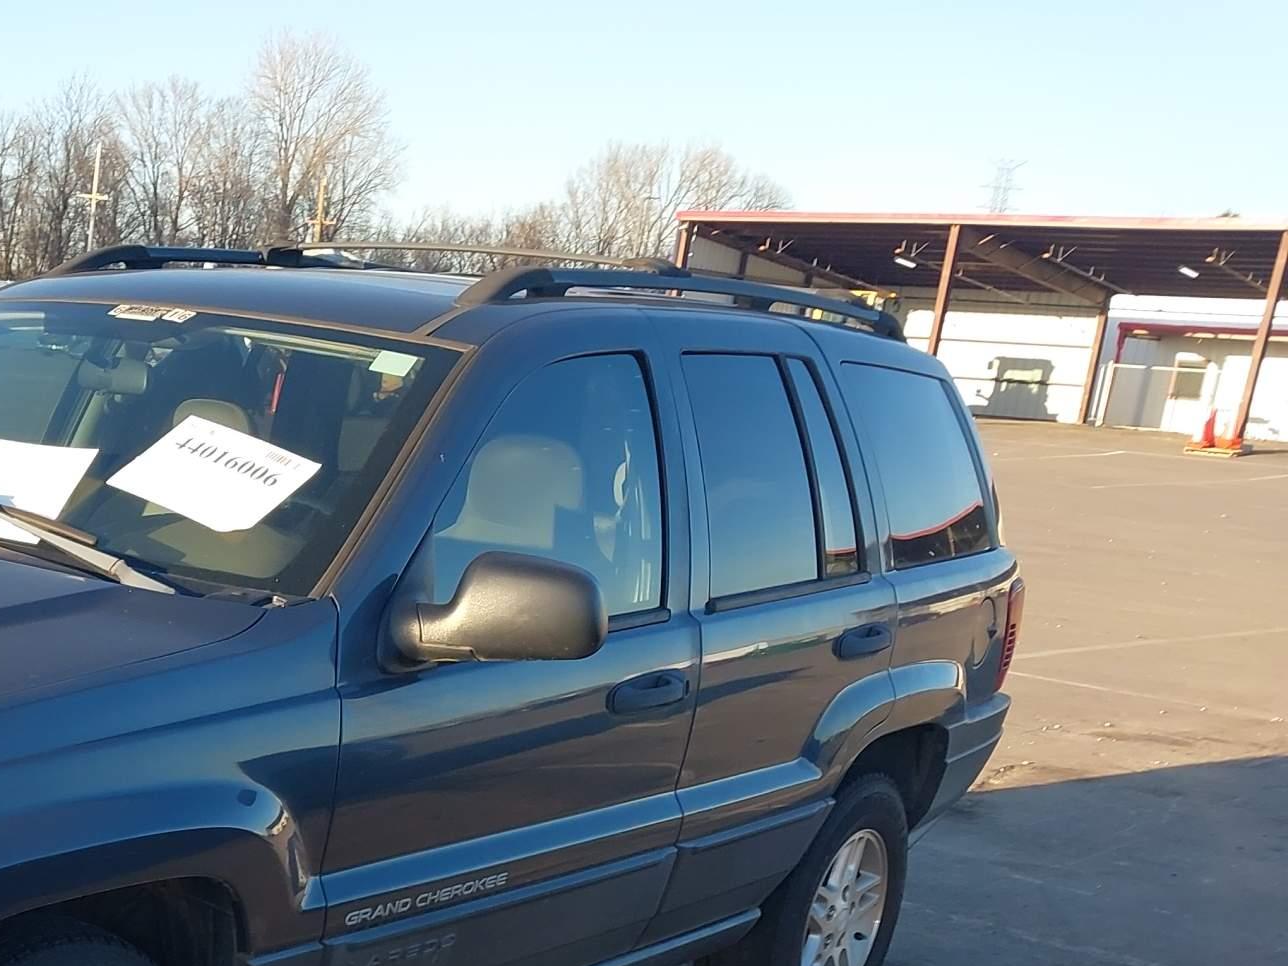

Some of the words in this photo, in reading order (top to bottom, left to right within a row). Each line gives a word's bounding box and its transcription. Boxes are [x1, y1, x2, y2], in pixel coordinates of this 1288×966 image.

[176, 438, 281, 487] 44016006
[344, 897, 412, 926] GRAND
[415, 872, 509, 908] CHEROKEE
